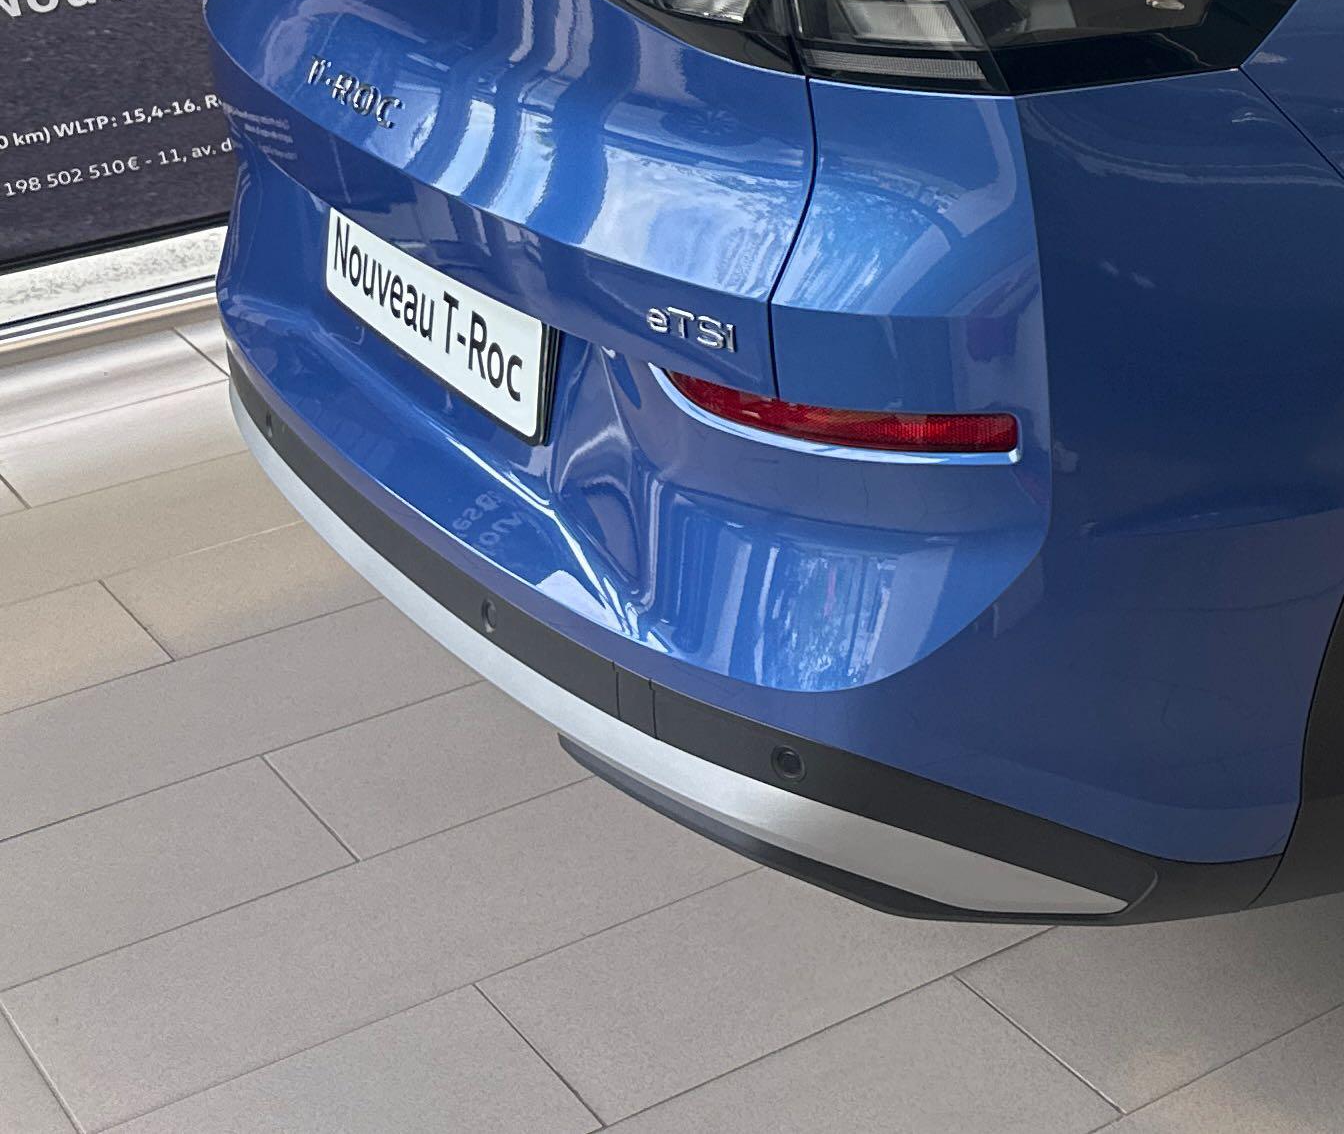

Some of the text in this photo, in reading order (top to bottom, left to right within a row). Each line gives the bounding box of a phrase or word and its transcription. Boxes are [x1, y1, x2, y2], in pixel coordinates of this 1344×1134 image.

[14, 127, 51, 146] km)
[53, 115, 119, 139] WLTP:
[122, 99, 202, 126] 15,4-16.
[204, 93, 223, 110] R
[4, 176, 42, 197] 198
[46, 168, 84, 189] 502
[157, 148, 188, 167] 11,
[191, 144, 218, 159] av.
[333, 217, 524, 402] Nouveau T-Roc
